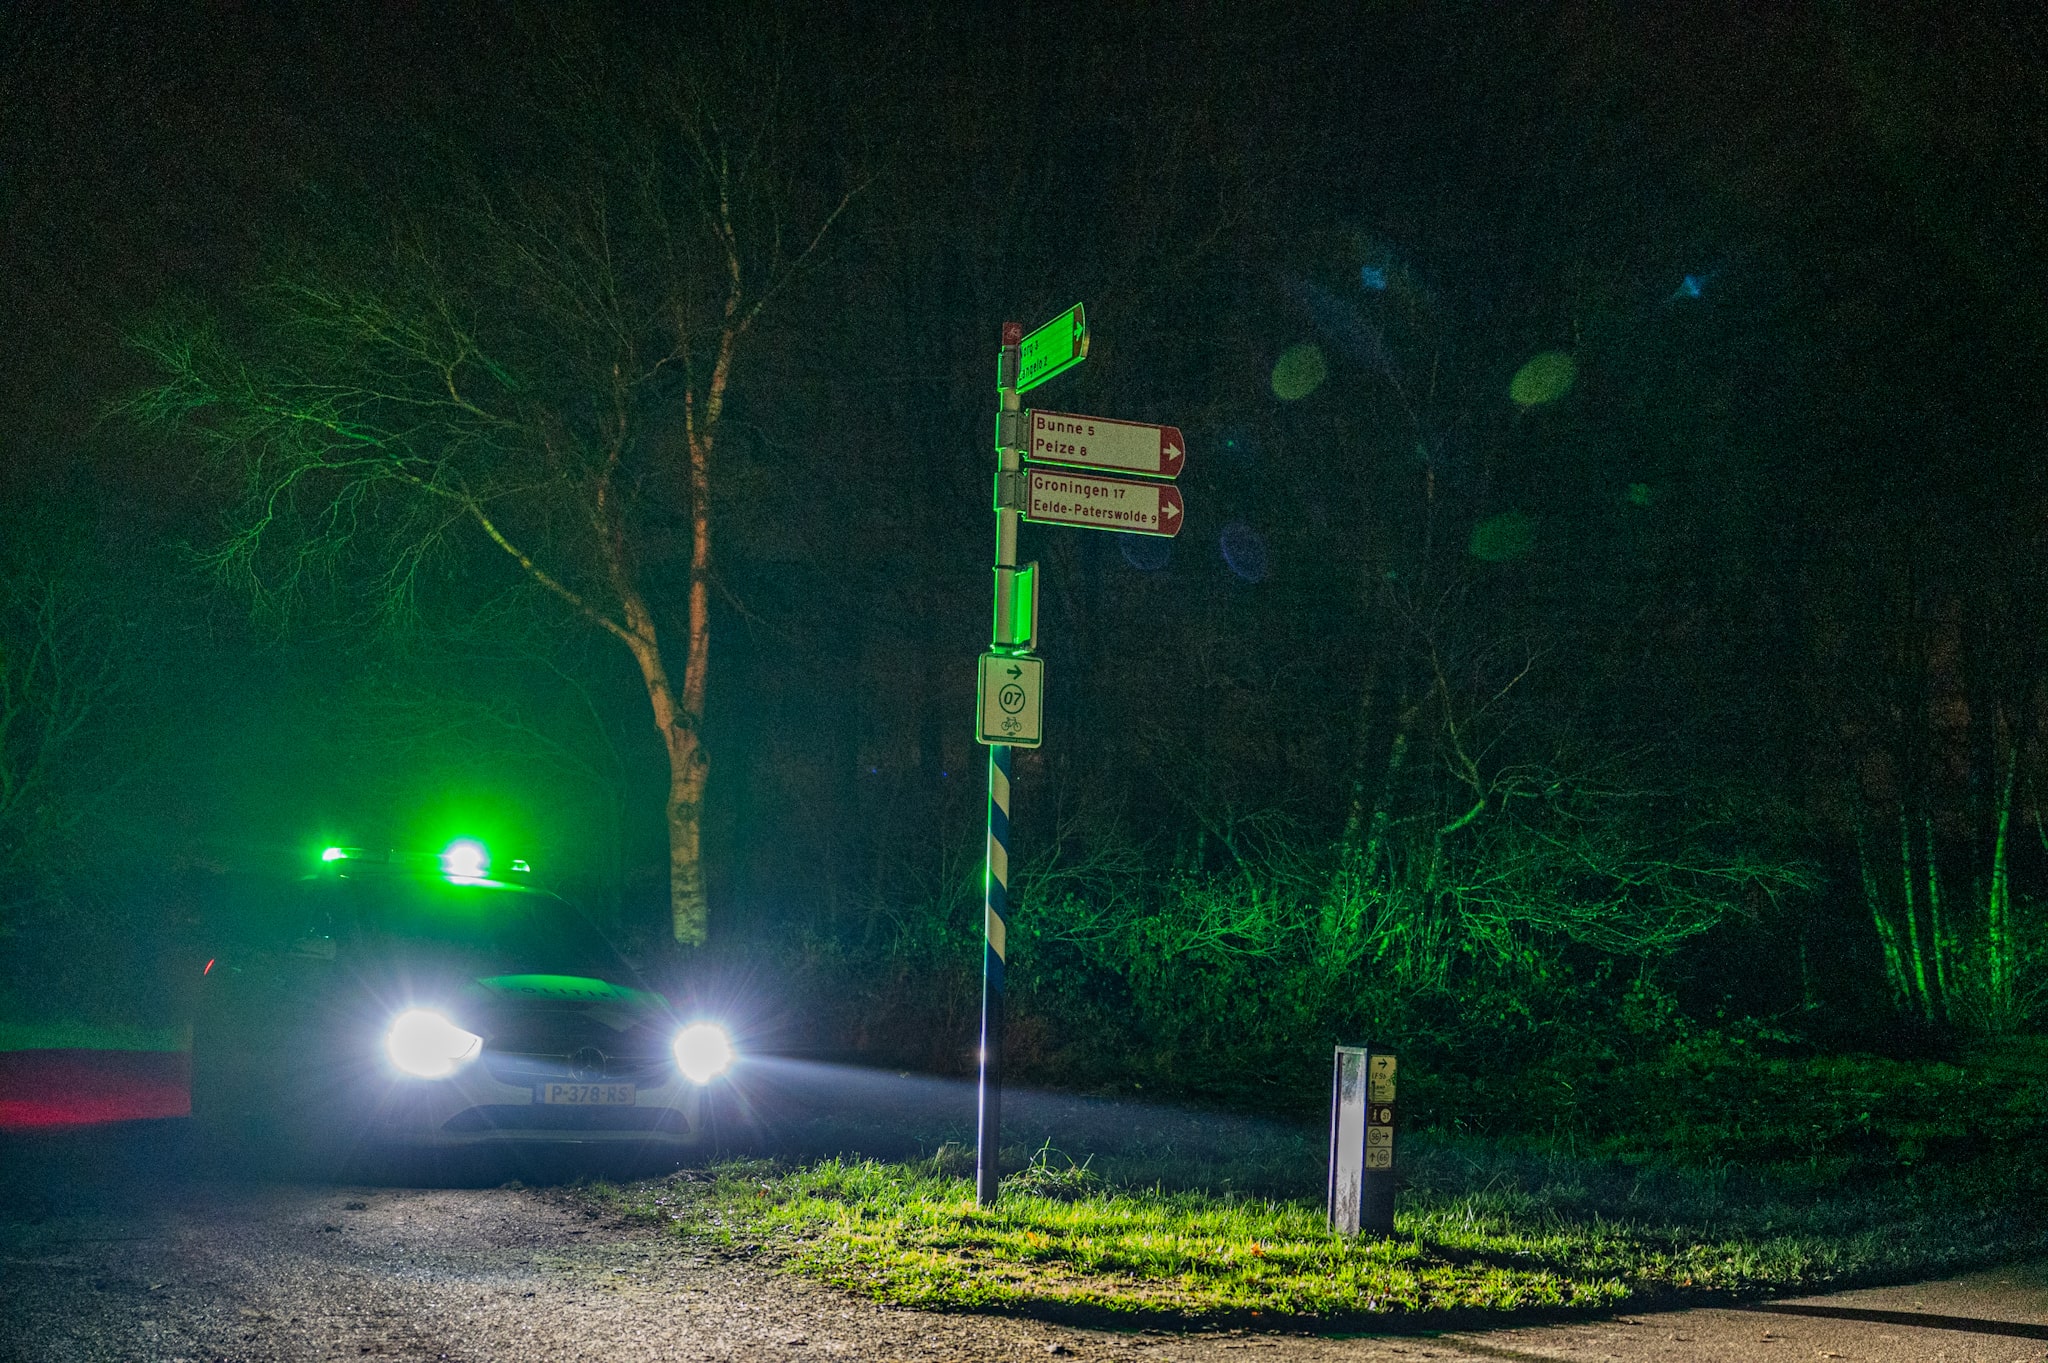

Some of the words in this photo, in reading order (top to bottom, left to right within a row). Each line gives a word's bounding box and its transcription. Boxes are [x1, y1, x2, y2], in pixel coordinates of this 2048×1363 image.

[1036, 417, 1083, 435] Bunne
[1088, 426, 1095, 436] 5
[1036, 439, 1075, 455] Peize
[1080, 446, 1087, 456] 8
[1034, 477, 1108, 498] Groningen
[1113, 489, 1126, 499] 17
[1034, 499, 1147, 522] Eelde-Paterswolde
[1003, 691, 1022, 706] 07
[551, 1085, 628, 1102] P-378-RS
